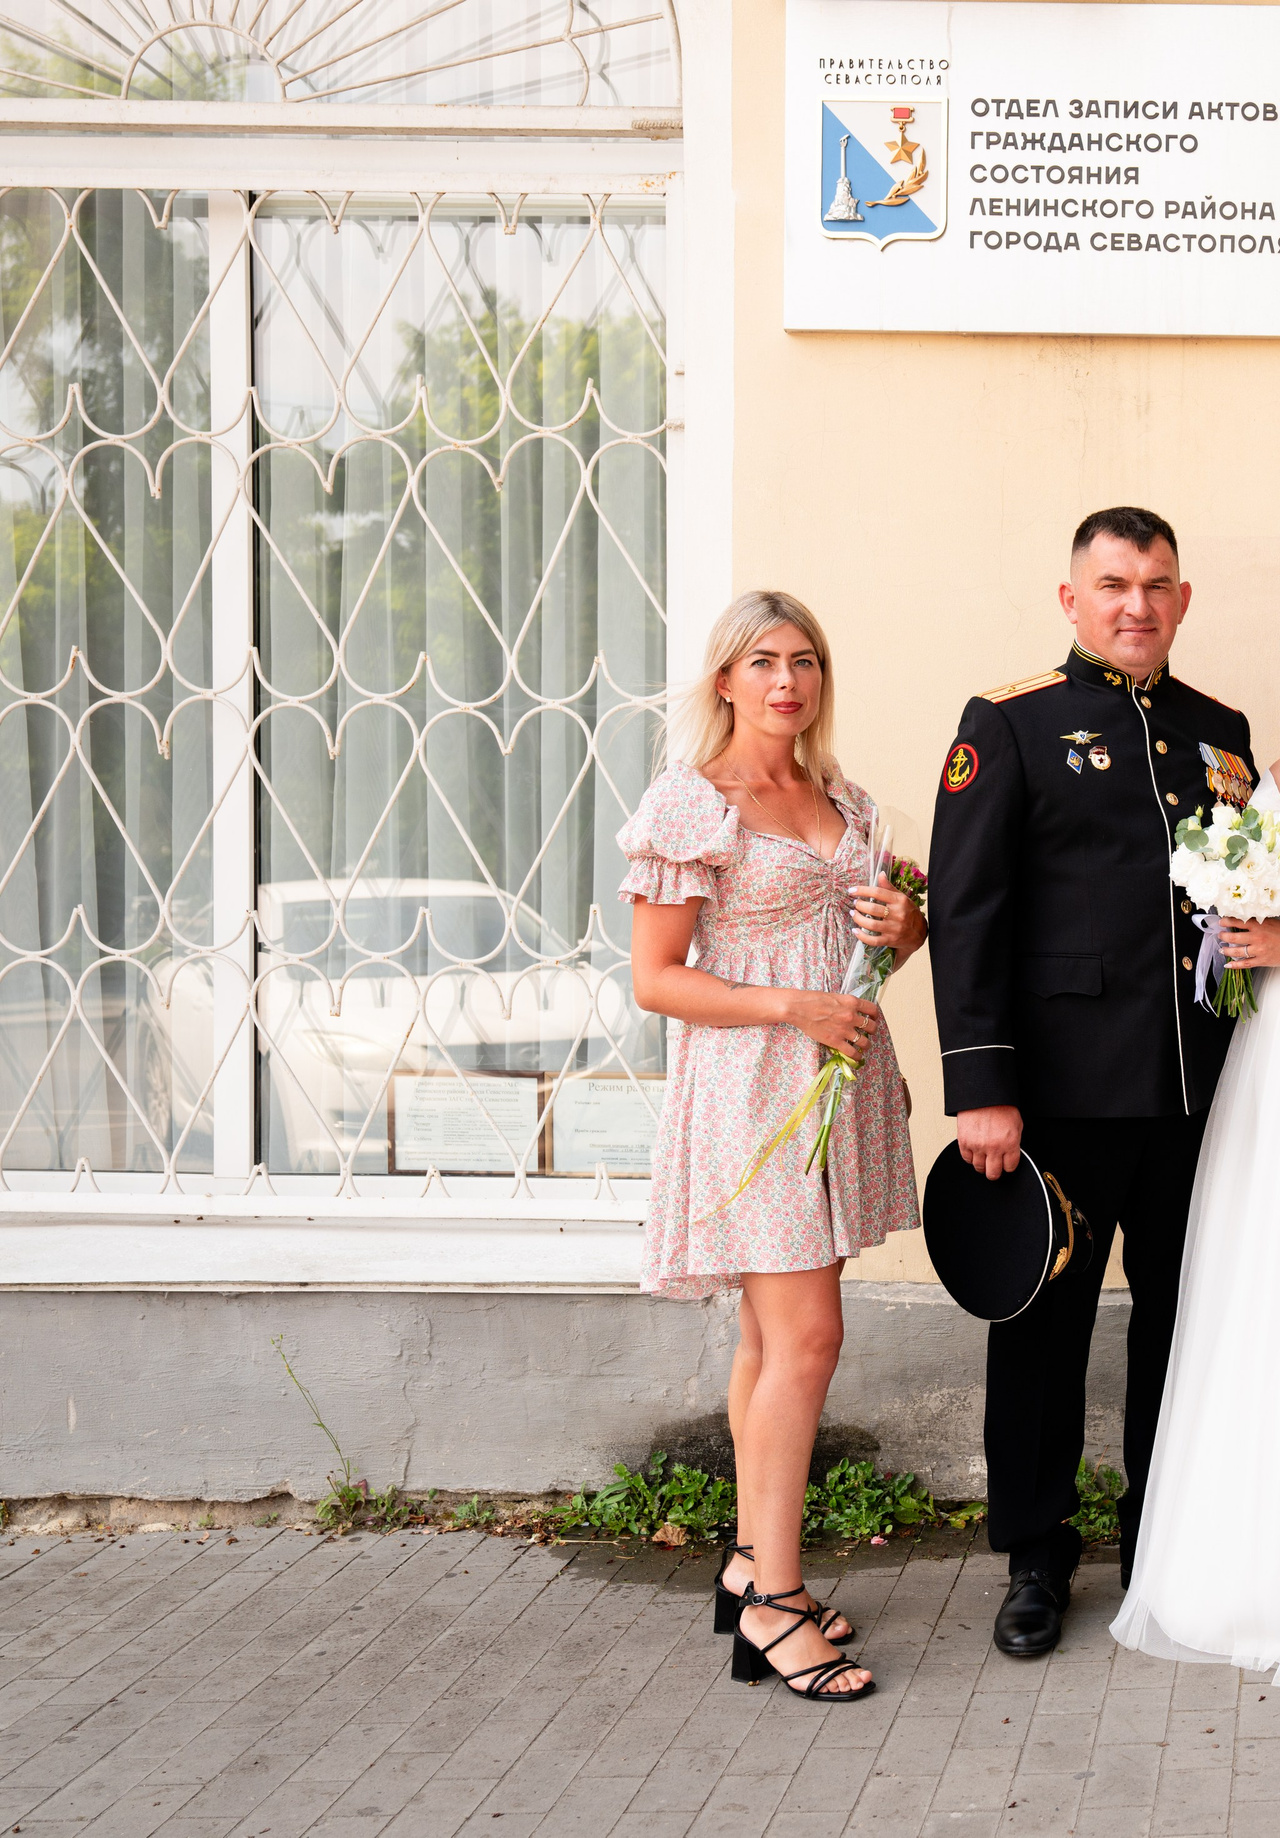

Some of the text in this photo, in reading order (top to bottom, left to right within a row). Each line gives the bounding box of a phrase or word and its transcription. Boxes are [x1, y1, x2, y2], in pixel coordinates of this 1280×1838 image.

[819, 58, 950, 71] ПРАВИТЕЛЬСТВО
[824, 73, 942, 86] СЕВАСТОПОЛЯ
[970, 98, 1279, 122] ОТДЕЛ ЗАПИСИ АКТОВ
[970, 131, 1199, 154] ГРАЖДАНСКОГО
[969, 165, 1139, 185] СОСТОЯНИЯ
[969, 195, 1276, 221] ЛЕНИНСКОГО РАЙОНА
[969, 231, 1080, 253] ГОРОДА
[588, 1082, 623, 1092] Режим
